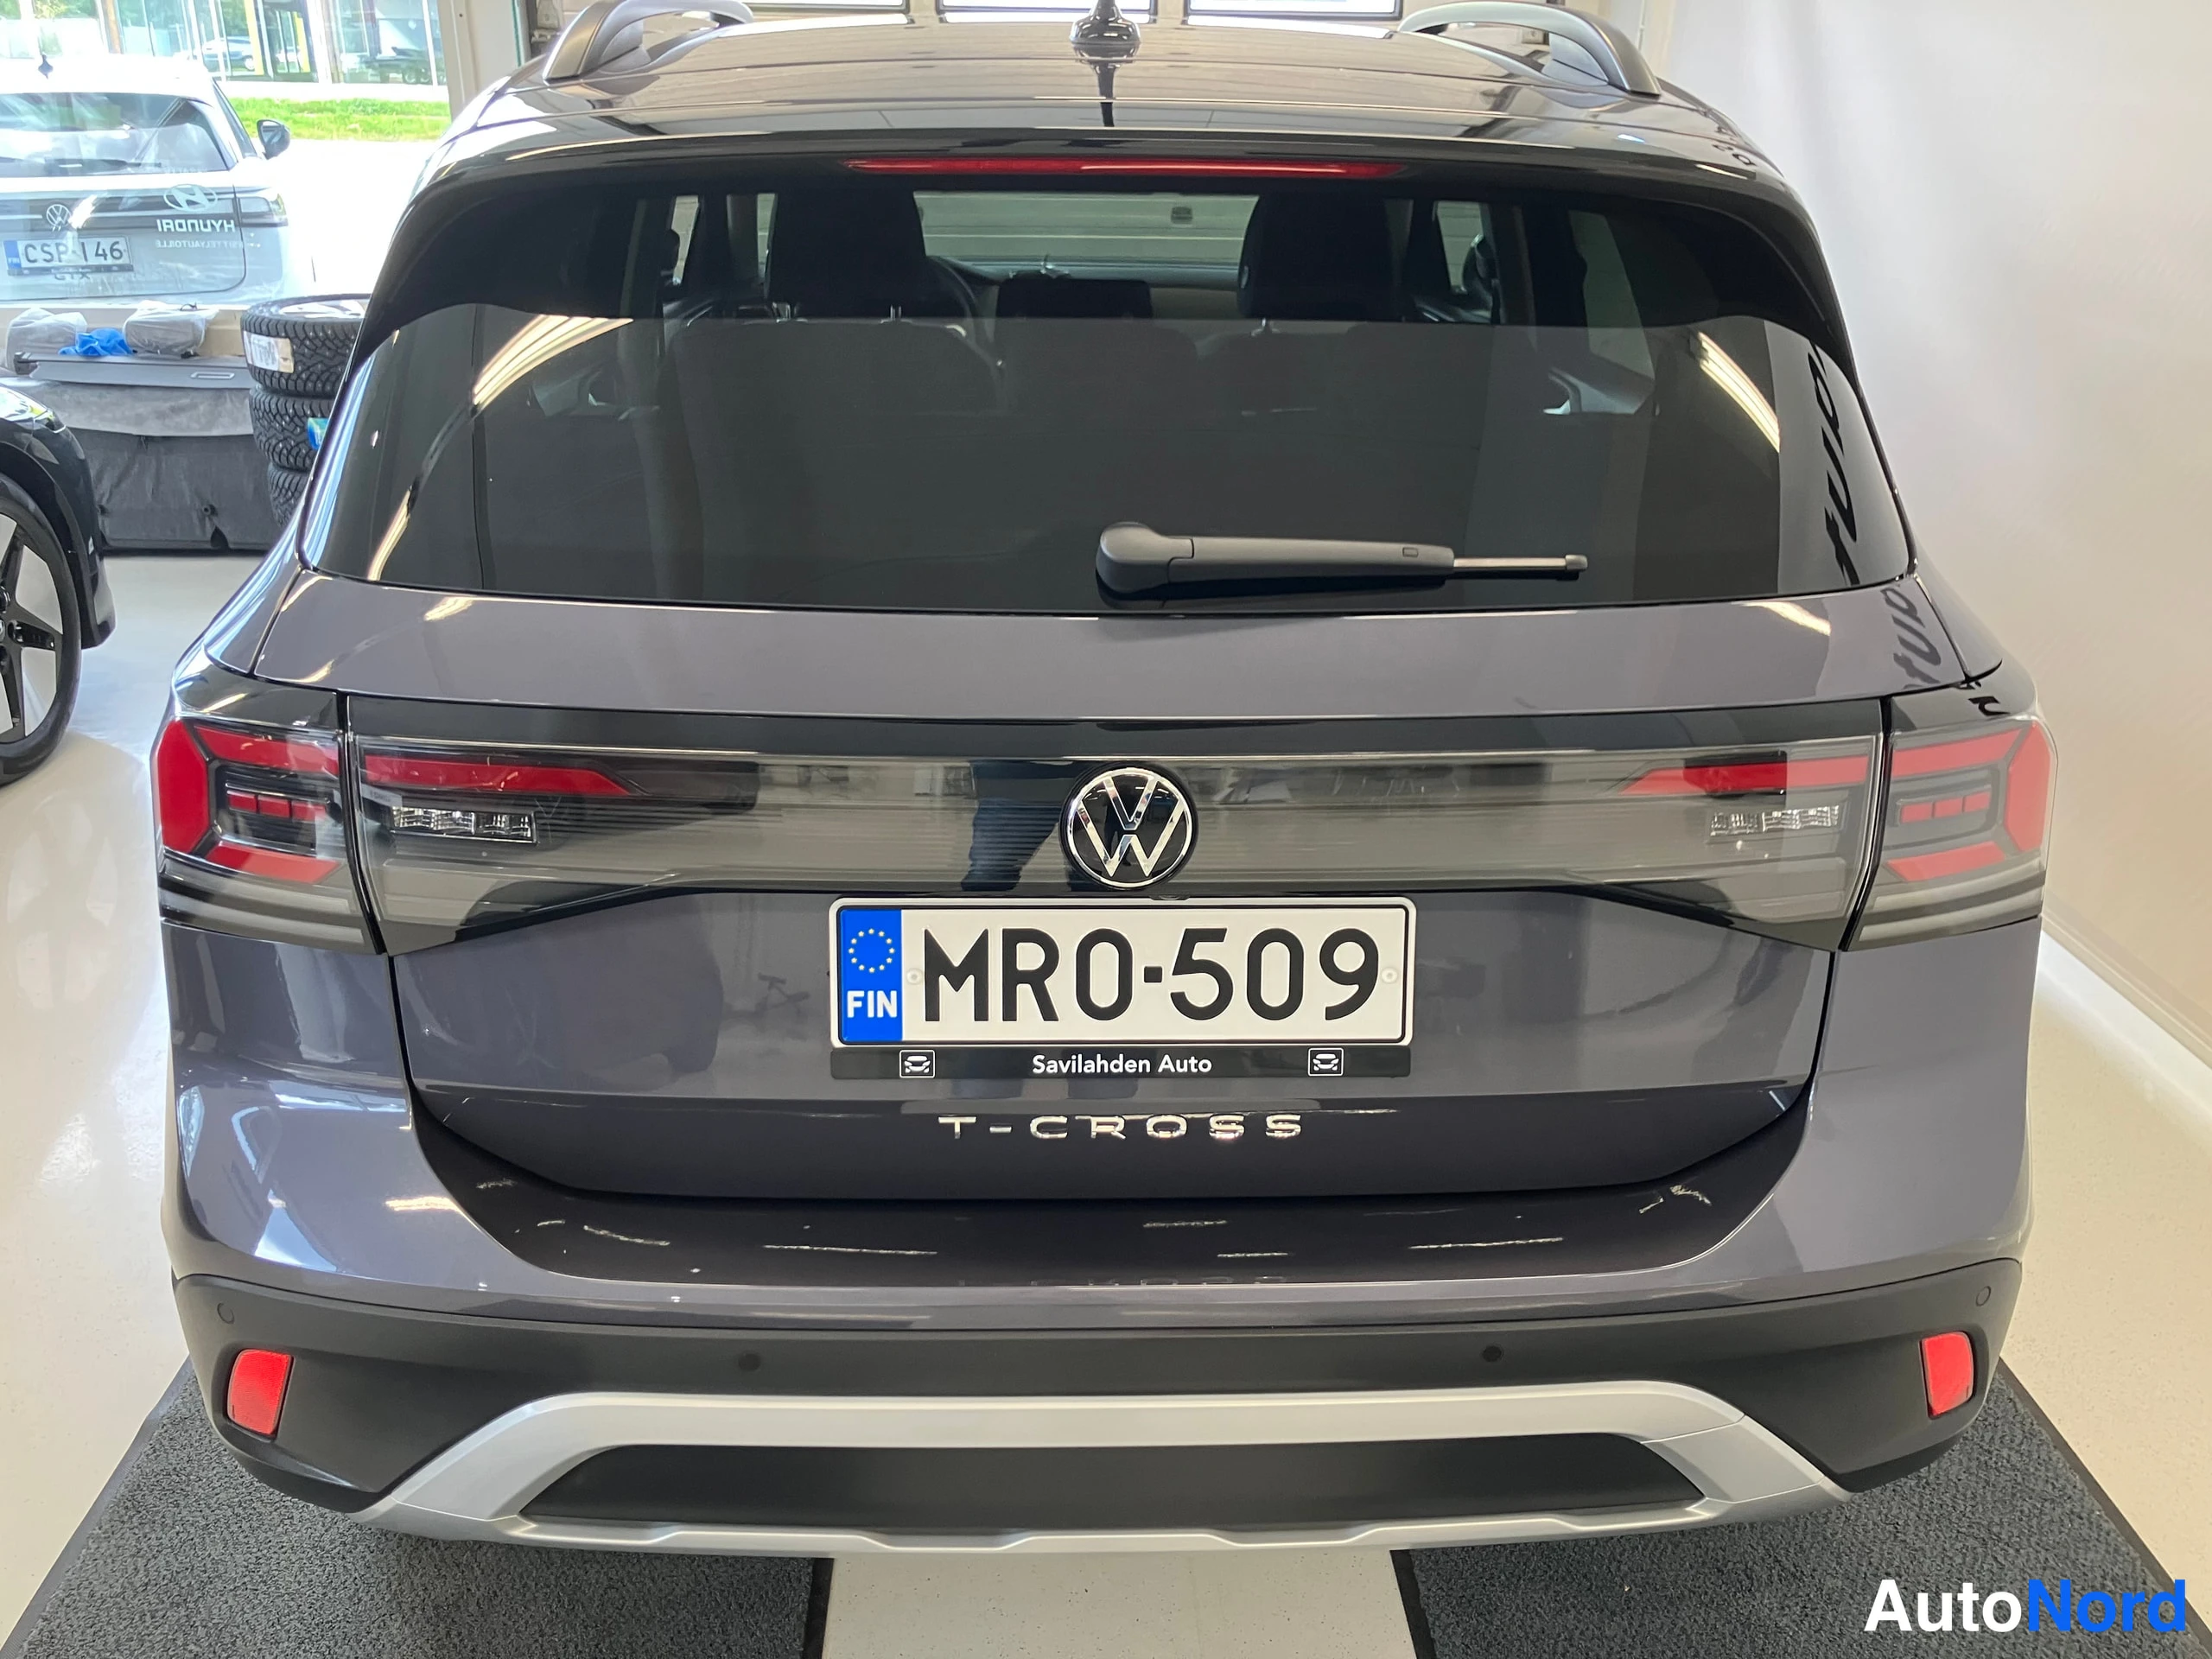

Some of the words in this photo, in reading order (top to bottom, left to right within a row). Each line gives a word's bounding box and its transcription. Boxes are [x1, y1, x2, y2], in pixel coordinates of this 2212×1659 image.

[924, 927, 1379, 1022] MRO-509
[846, 990, 897, 1019] FIN
[1032, 1055, 1152, 1074] Savilahden
[1158, 1055, 1212, 1074] Auto
[938, 1115, 1302, 1140] T-CROSS
